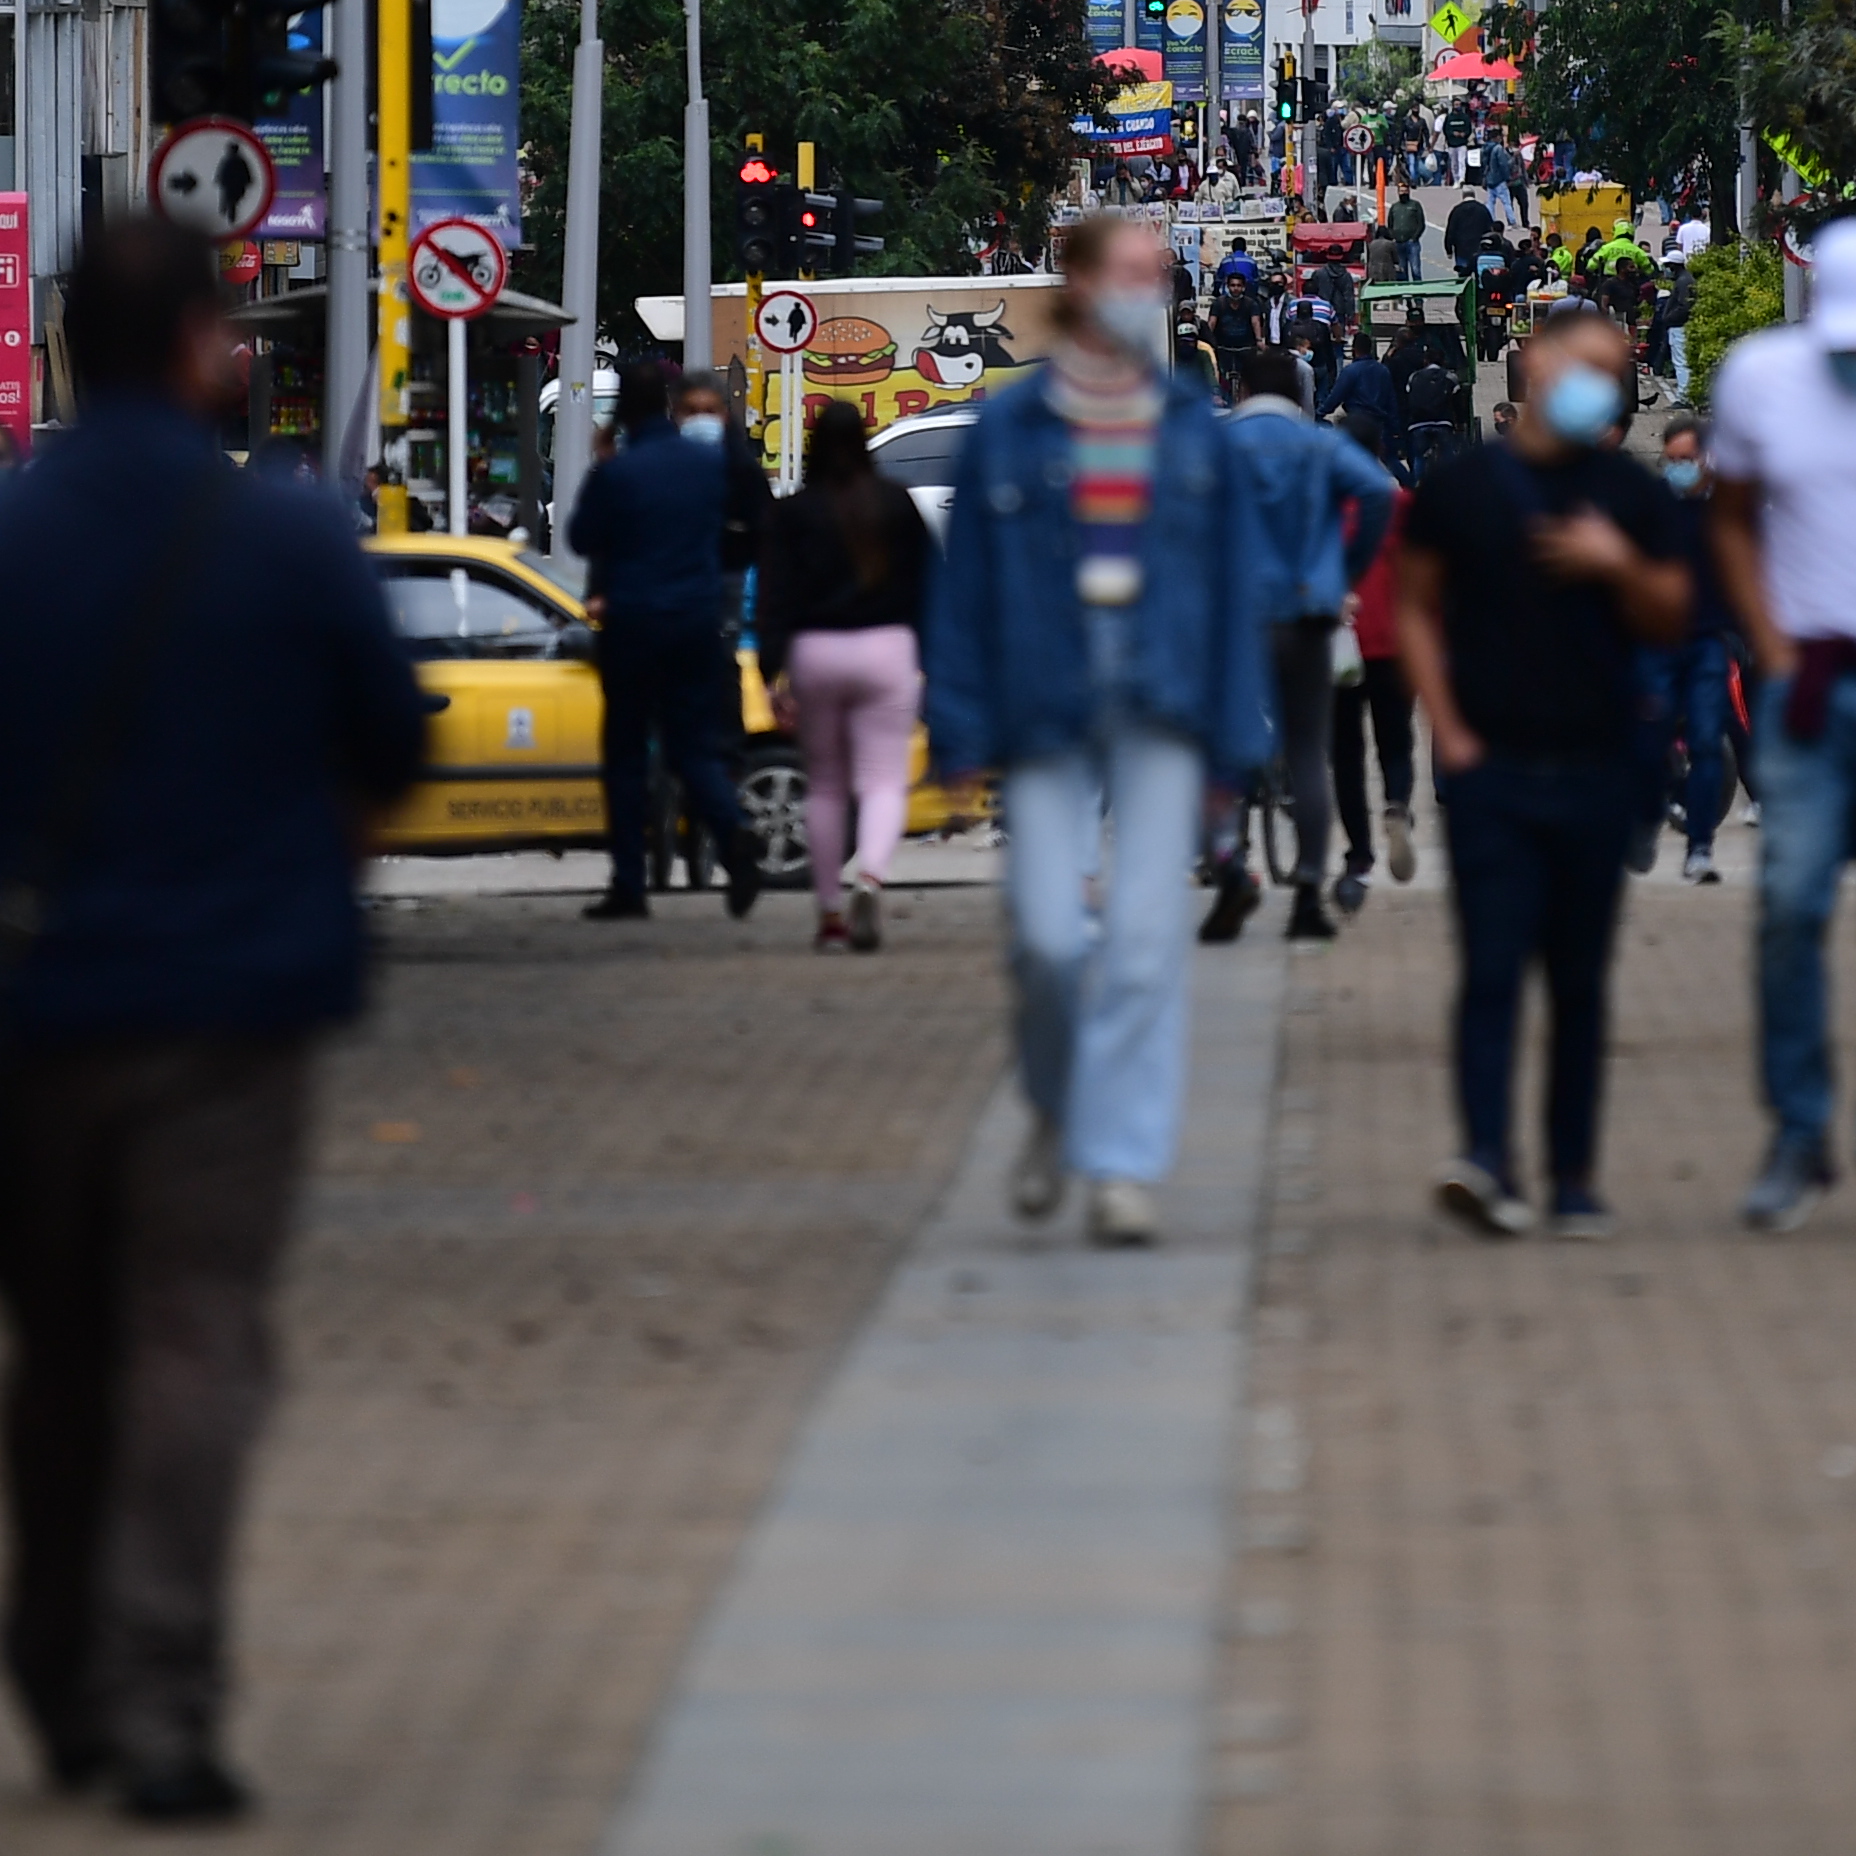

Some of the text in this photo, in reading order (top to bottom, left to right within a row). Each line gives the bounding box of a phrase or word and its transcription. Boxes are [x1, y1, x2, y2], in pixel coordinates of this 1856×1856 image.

[1088, 9, 1122, 17] correcto
[1166, 44, 1204, 53] correcto
[1230, 46, 1261, 56] crack
[434, 70, 510, 96] recto
